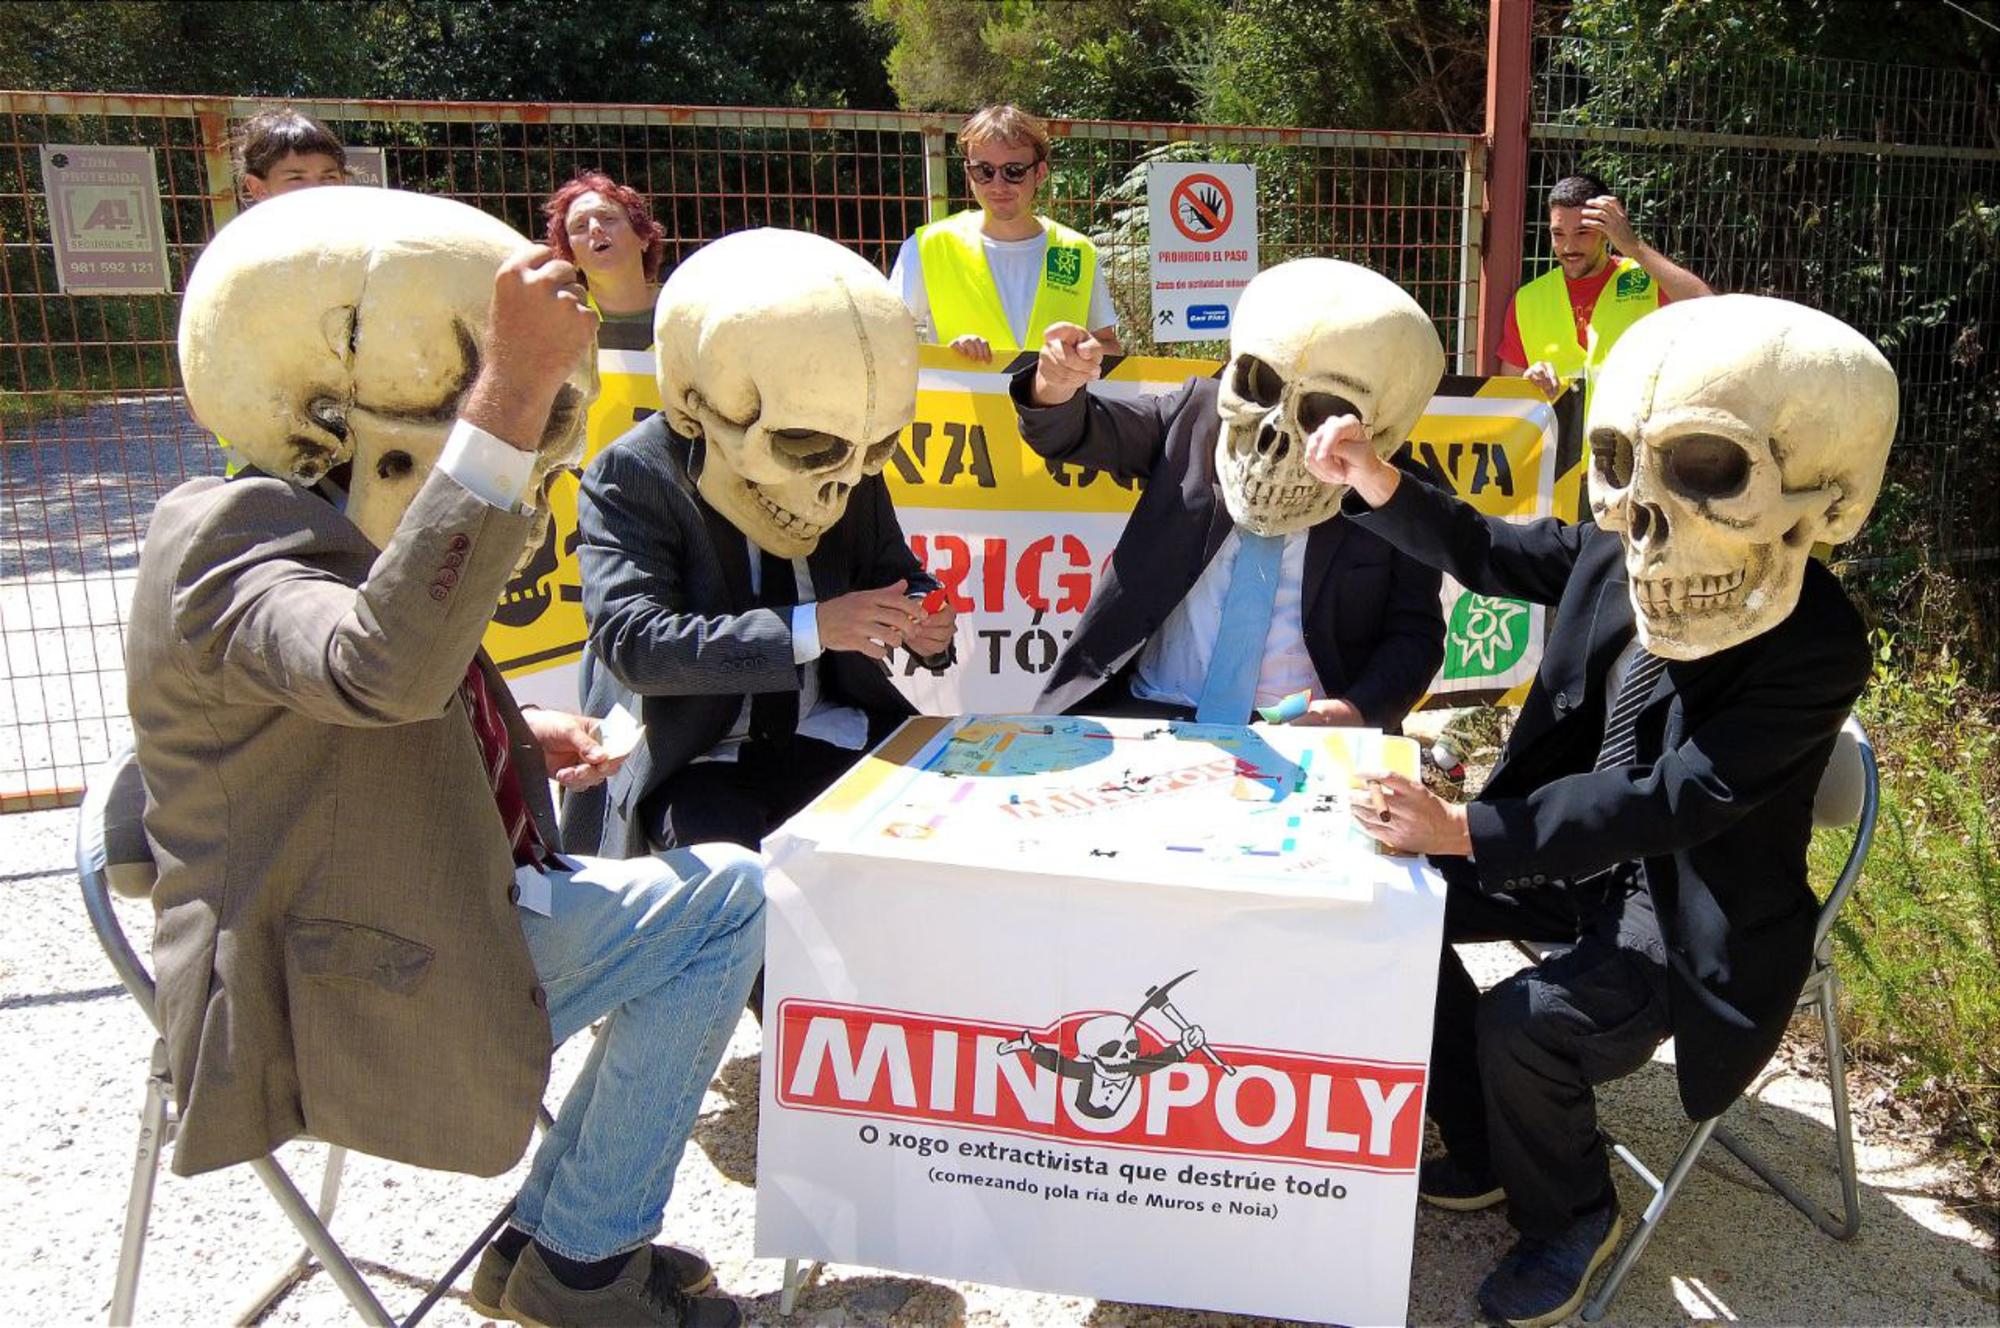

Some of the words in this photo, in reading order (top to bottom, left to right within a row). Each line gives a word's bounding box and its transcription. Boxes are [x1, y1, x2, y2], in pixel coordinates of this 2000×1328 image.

[80, 157, 117, 168] ZONA
[70, 262, 96, 273] 981
[100, 262, 126, 273] 592
[132, 262, 154, 273] 121
[1158, 251, 1210, 263] PROHIBIDO
[1213, 251, 1222, 262] EL
[1225, 250, 1248, 261] PASO
[910, 533, 1113, 615] RIG
[789, 1015, 1419, 1157] MINOPOLY
[858, 1124, 880, 1145] O
[888, 1132, 950, 1158] xogo
[958, 1141, 1109, 1176] extractivista
[1119, 1162, 1168, 1185] que
[1177, 1164, 1277, 1192] destrúe
[1285, 1175, 1348, 1200] todo
[928, 1166, 1039, 1195] (comezando
[1116, 1189, 1139, 1206] de
[1144, 1192, 1205, 1212] Muros
[1211, 1201, 1223, 1214] e
[1228, 1200, 1279, 1221] Noia)
